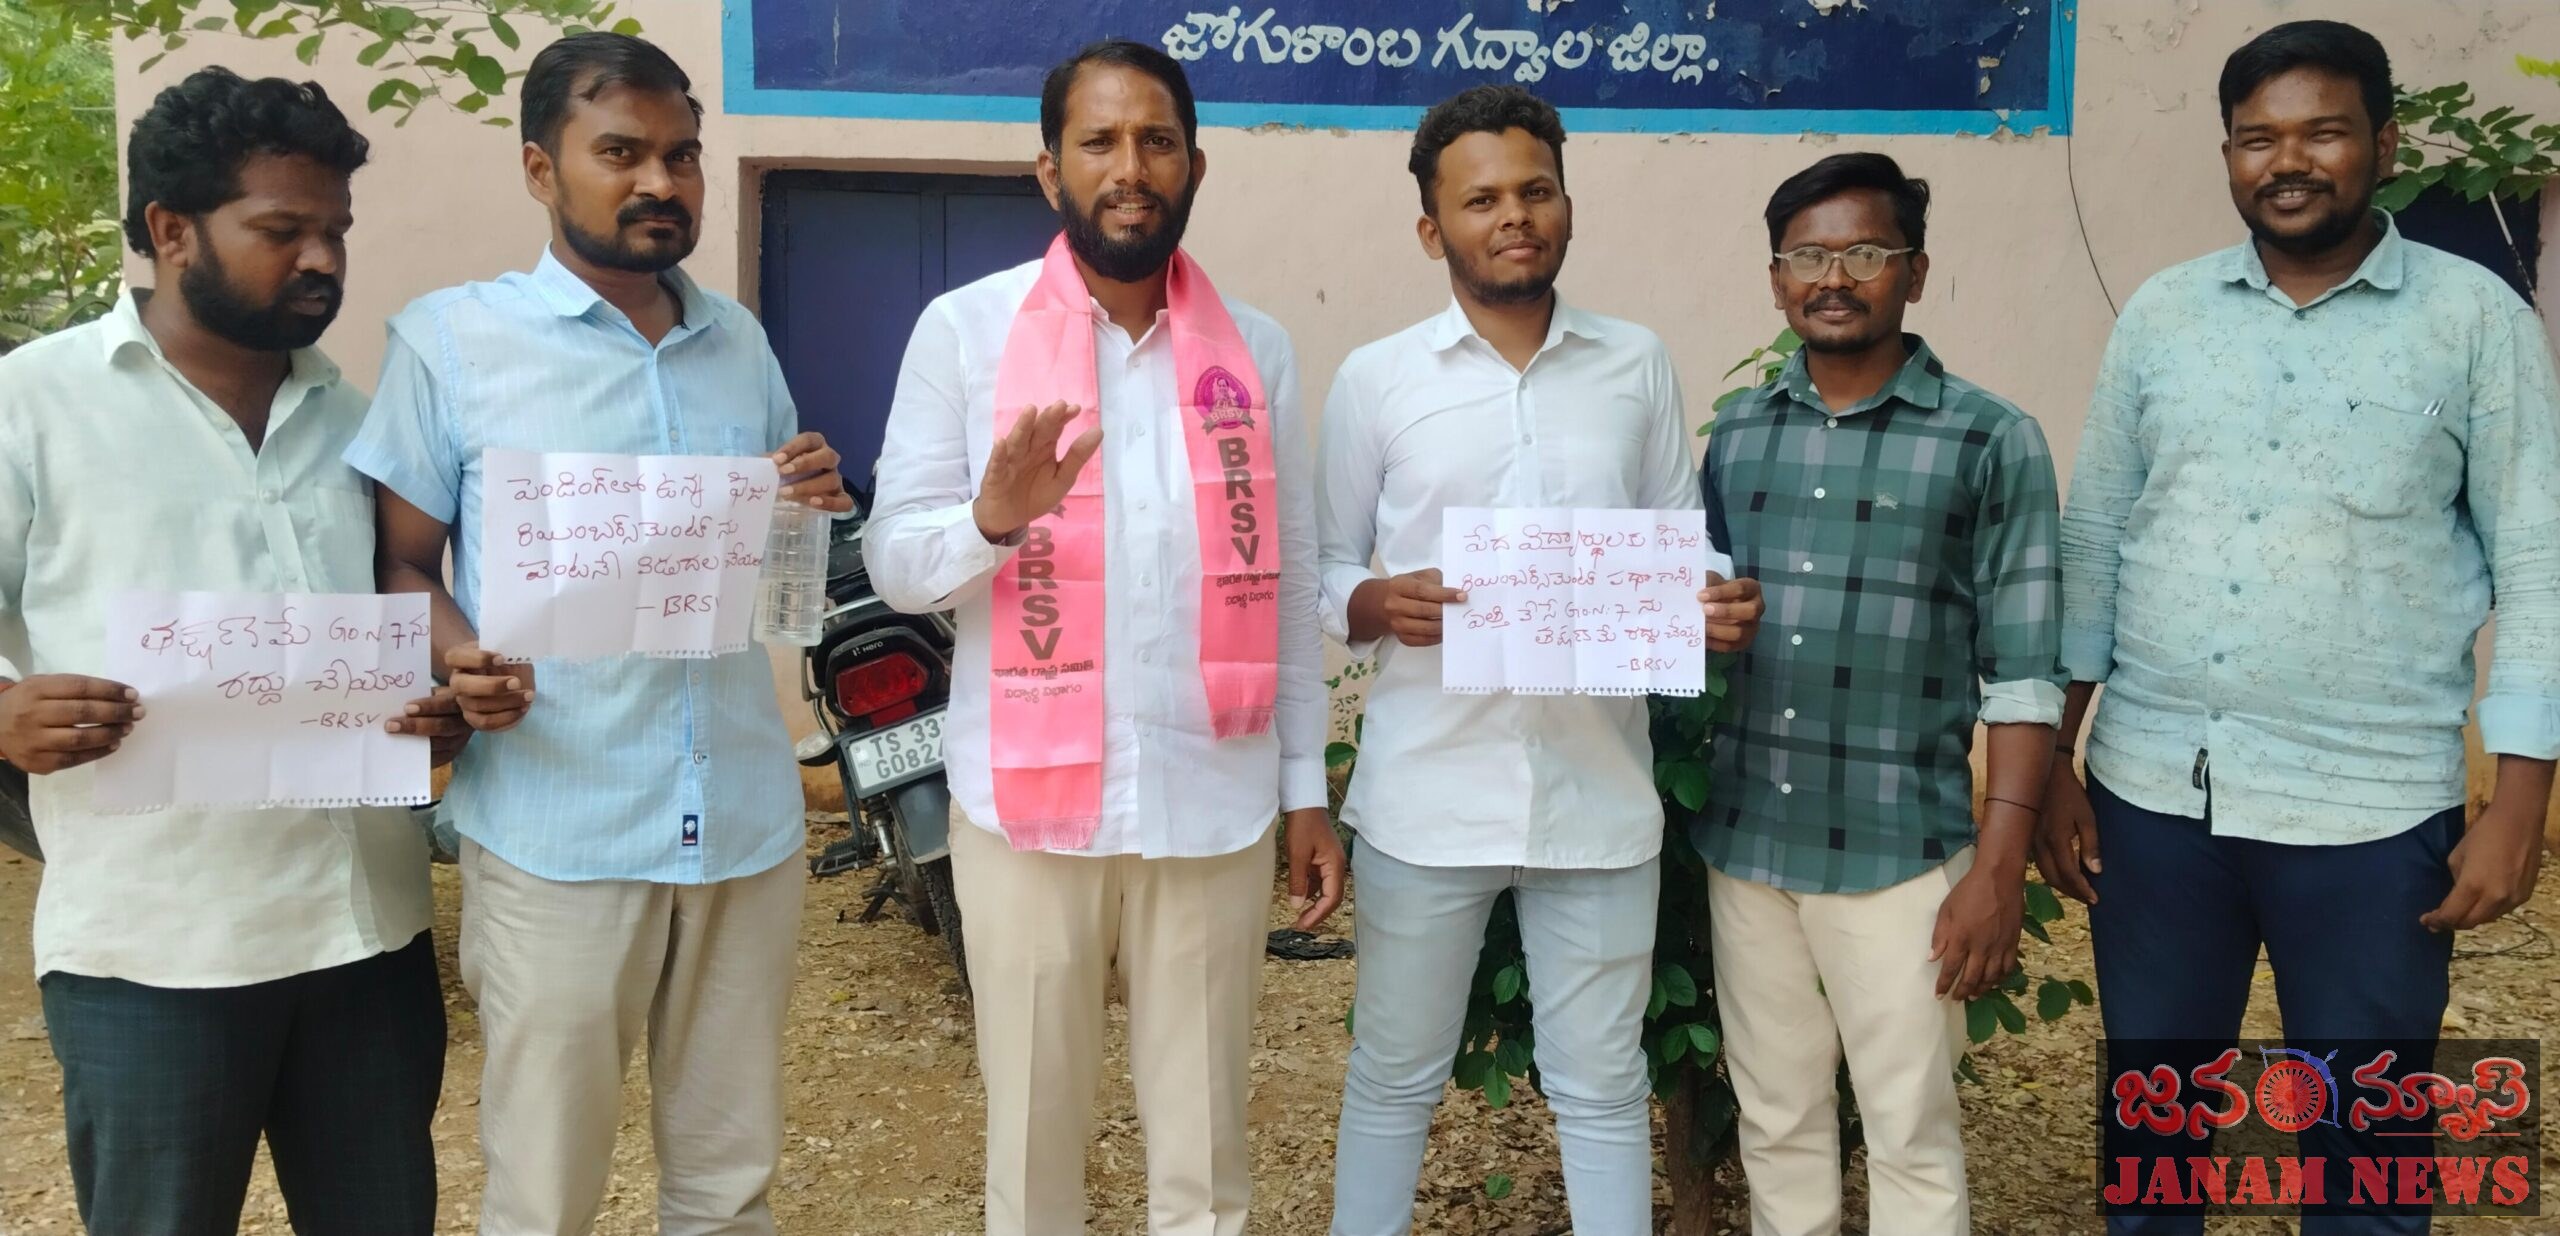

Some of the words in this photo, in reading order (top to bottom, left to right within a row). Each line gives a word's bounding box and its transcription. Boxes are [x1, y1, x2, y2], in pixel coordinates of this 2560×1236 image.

[1432, 13, 1593, 83] గద్వాల
[1217, 436, 1260, 566] BRSV
[1017, 526, 1063, 661] BRSV
[869, 731, 902, 758] TS
